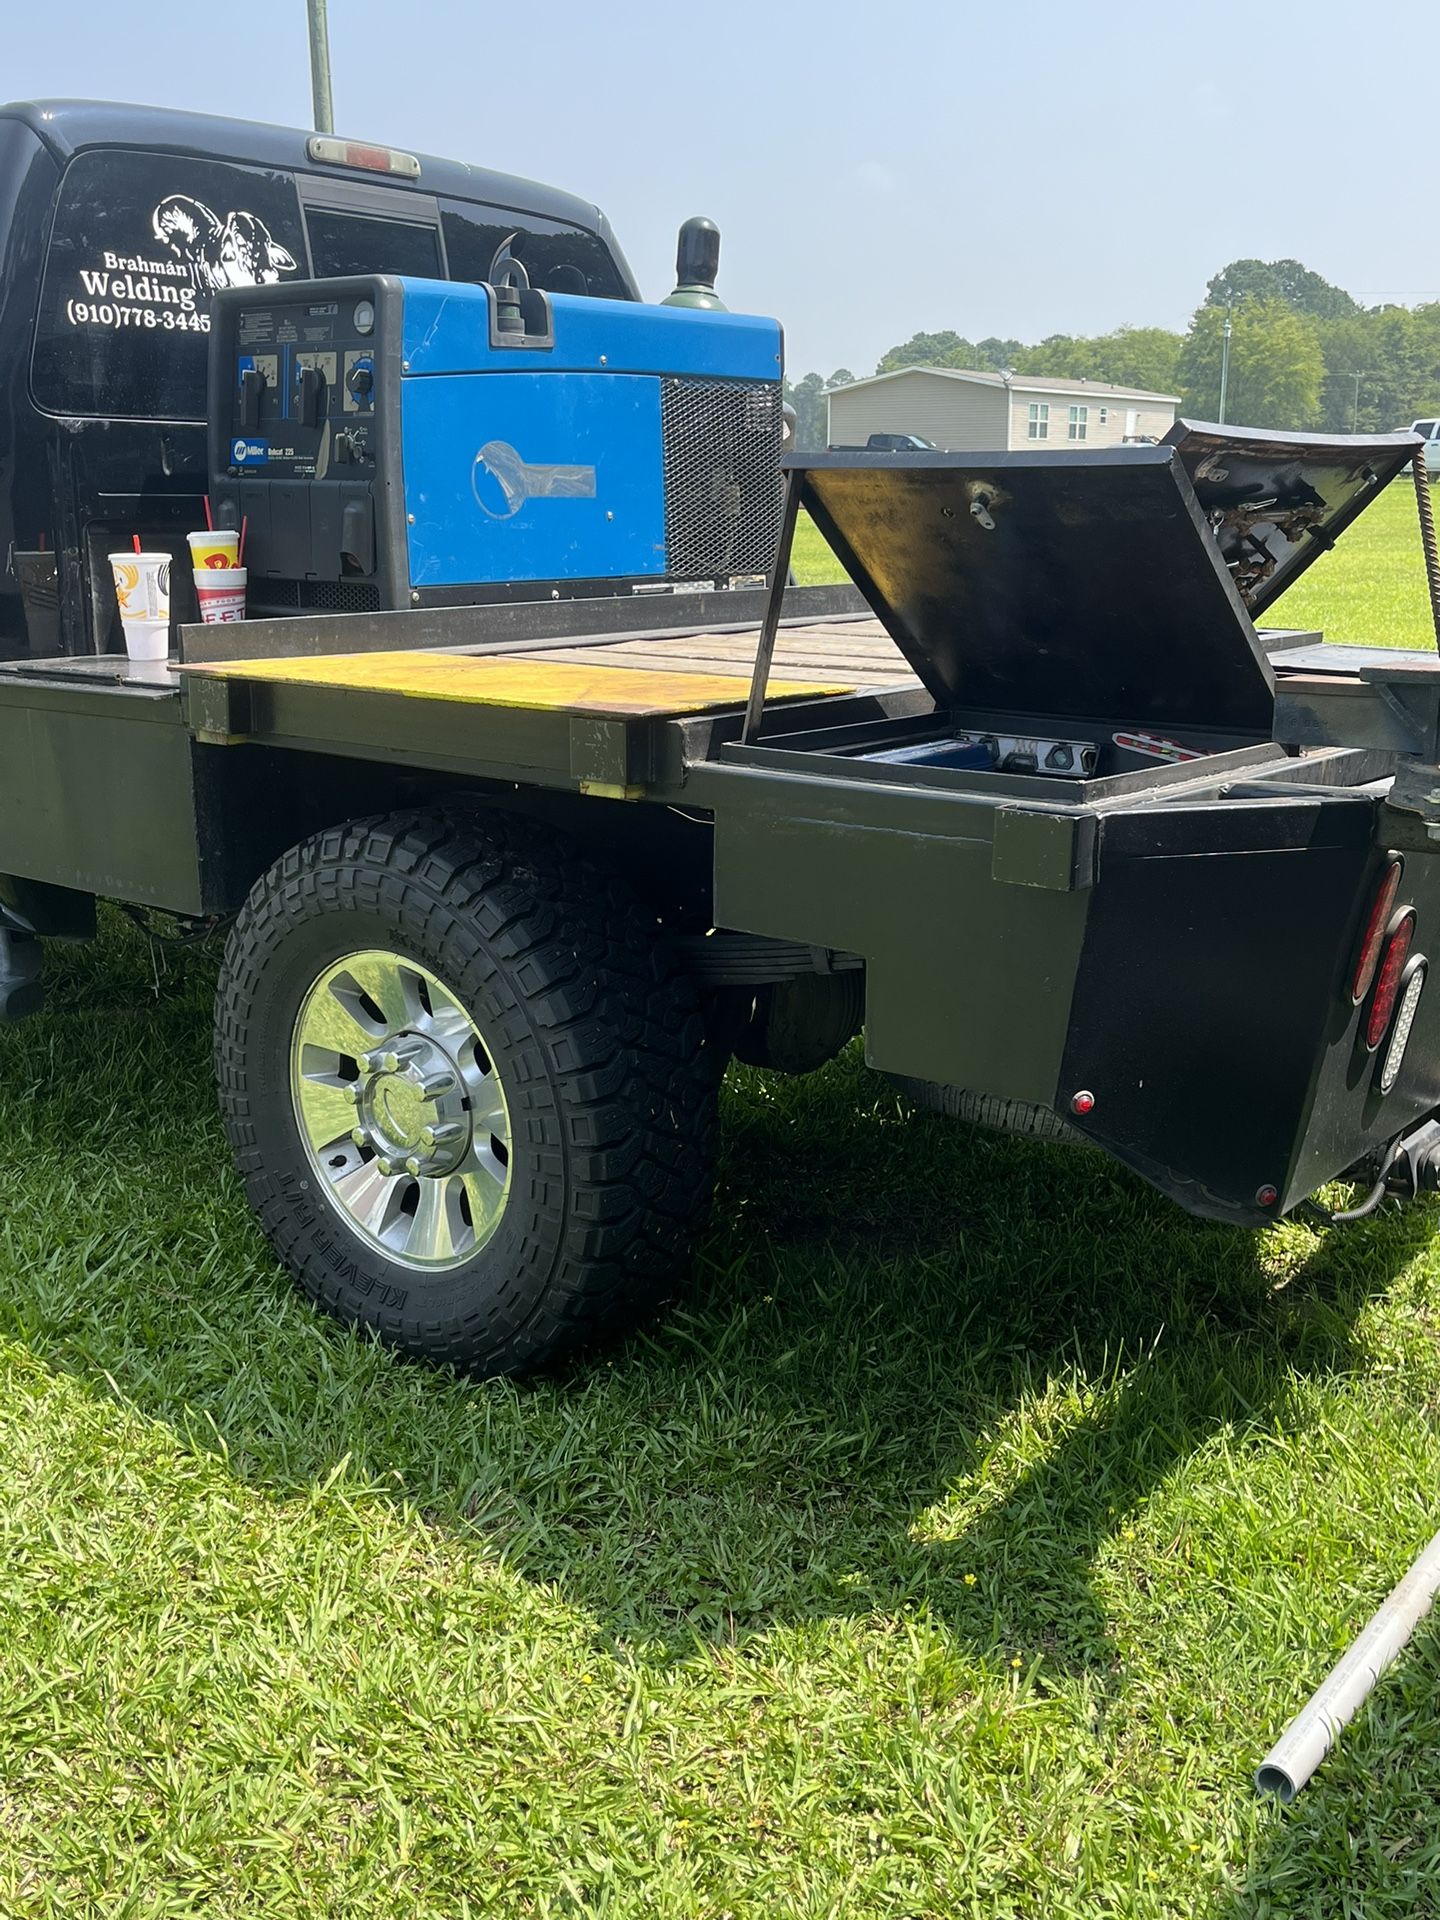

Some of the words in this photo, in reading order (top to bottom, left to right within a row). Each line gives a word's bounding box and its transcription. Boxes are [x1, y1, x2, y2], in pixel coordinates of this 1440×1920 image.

[103, 252, 188, 277] Brahmán
[80, 270, 196, 311] Welding
[67, 299, 211, 331] (910)778-3445
[311, 1228, 408, 1310] KLEVER
